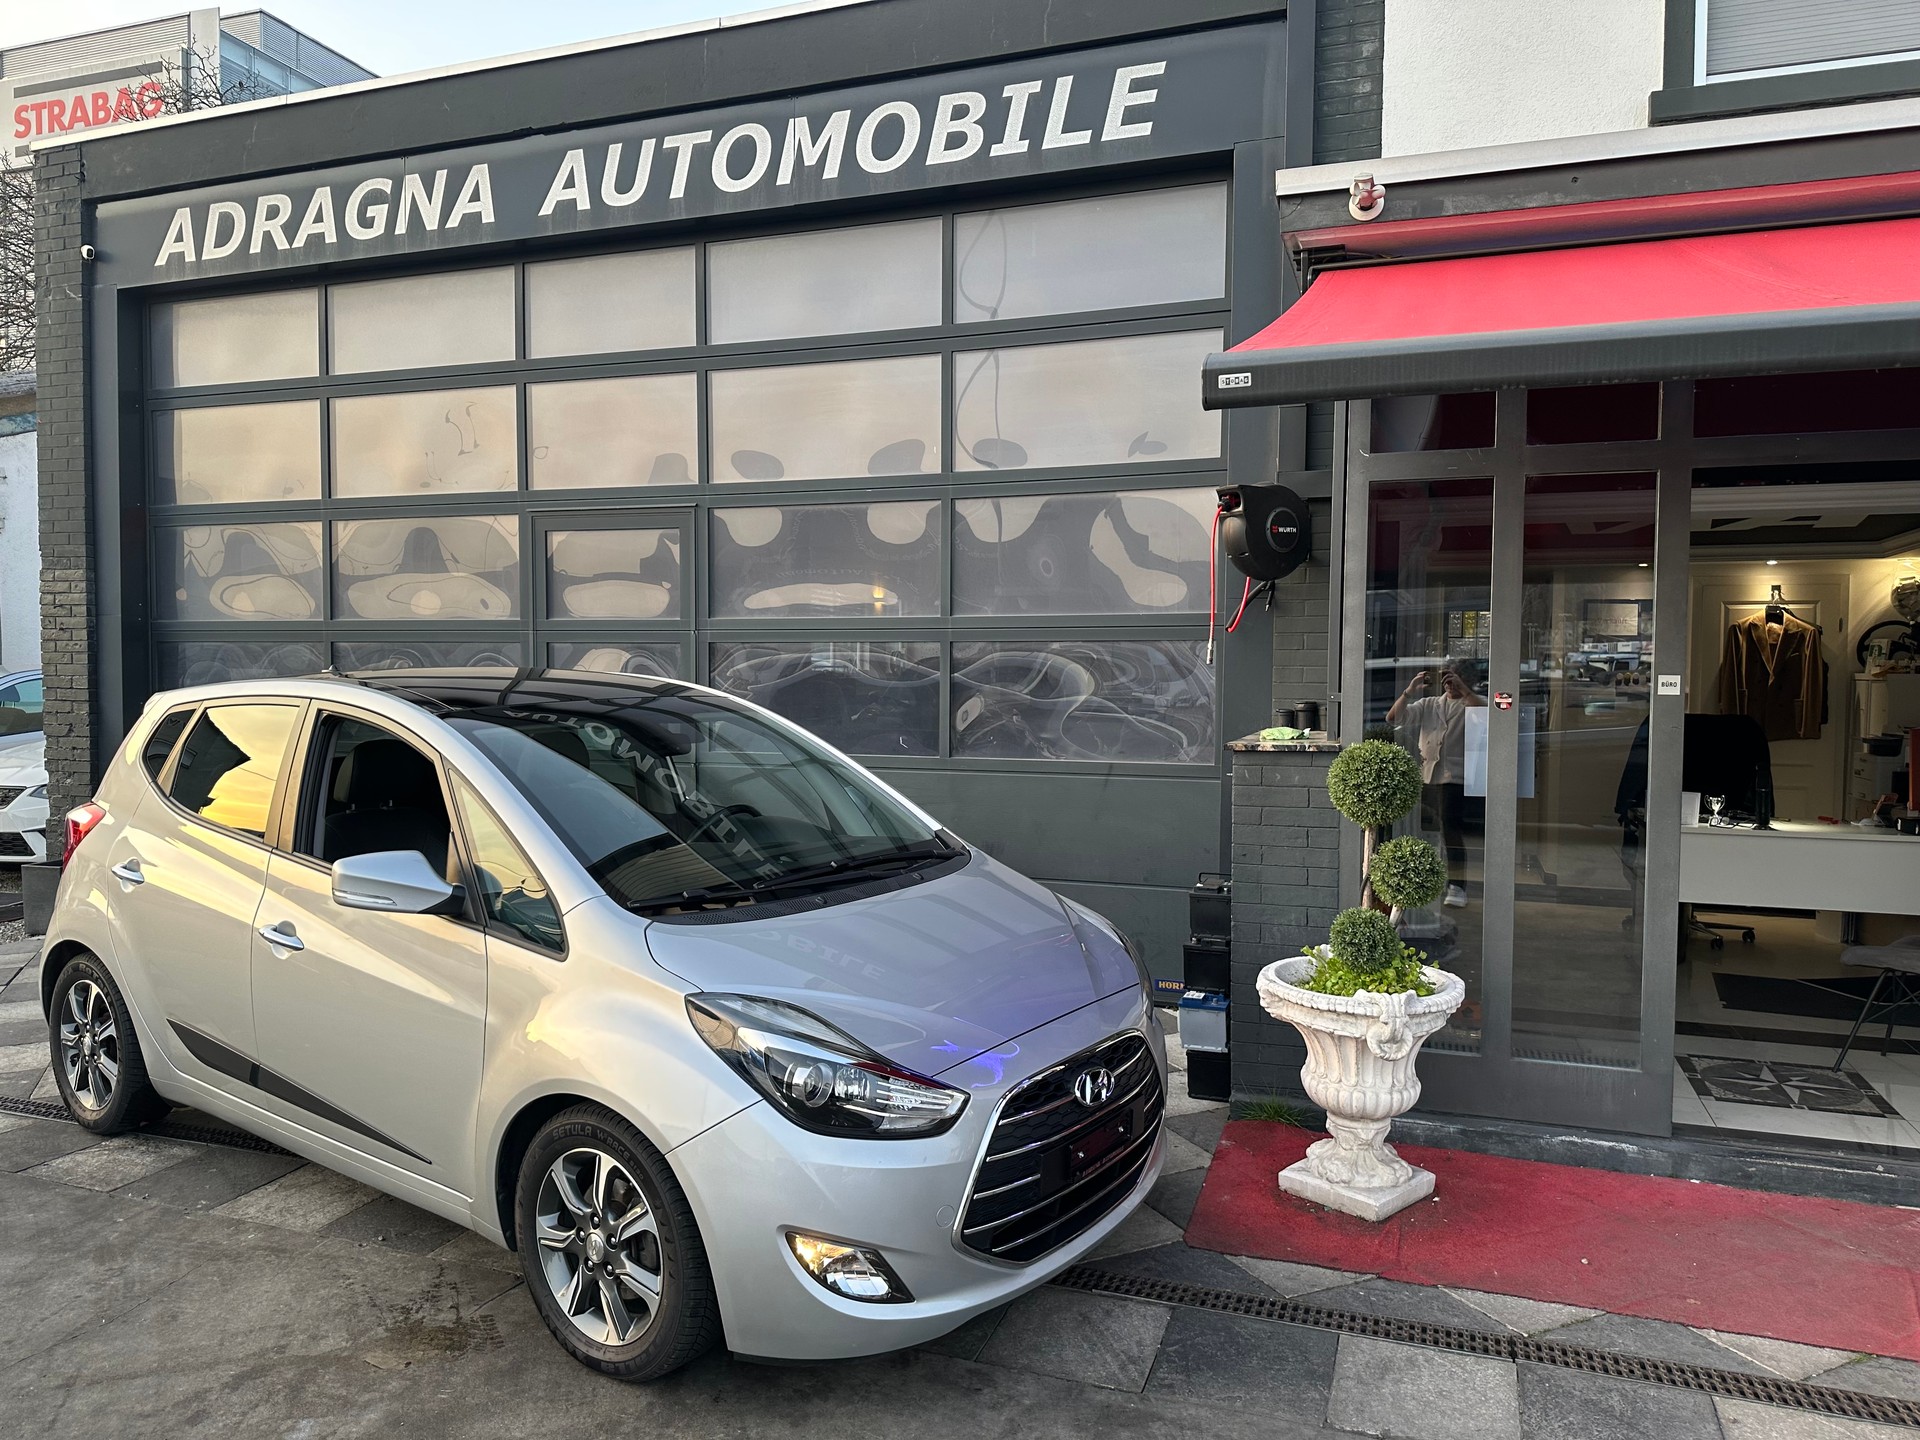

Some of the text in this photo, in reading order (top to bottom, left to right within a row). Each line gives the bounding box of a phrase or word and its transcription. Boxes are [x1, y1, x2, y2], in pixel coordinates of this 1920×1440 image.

[14, 81, 164, 139] STRABAG
[154, 61, 1167, 266] ADRAGNA AUTOMOBILE
[552, 1124, 592, 1140] SETULA
